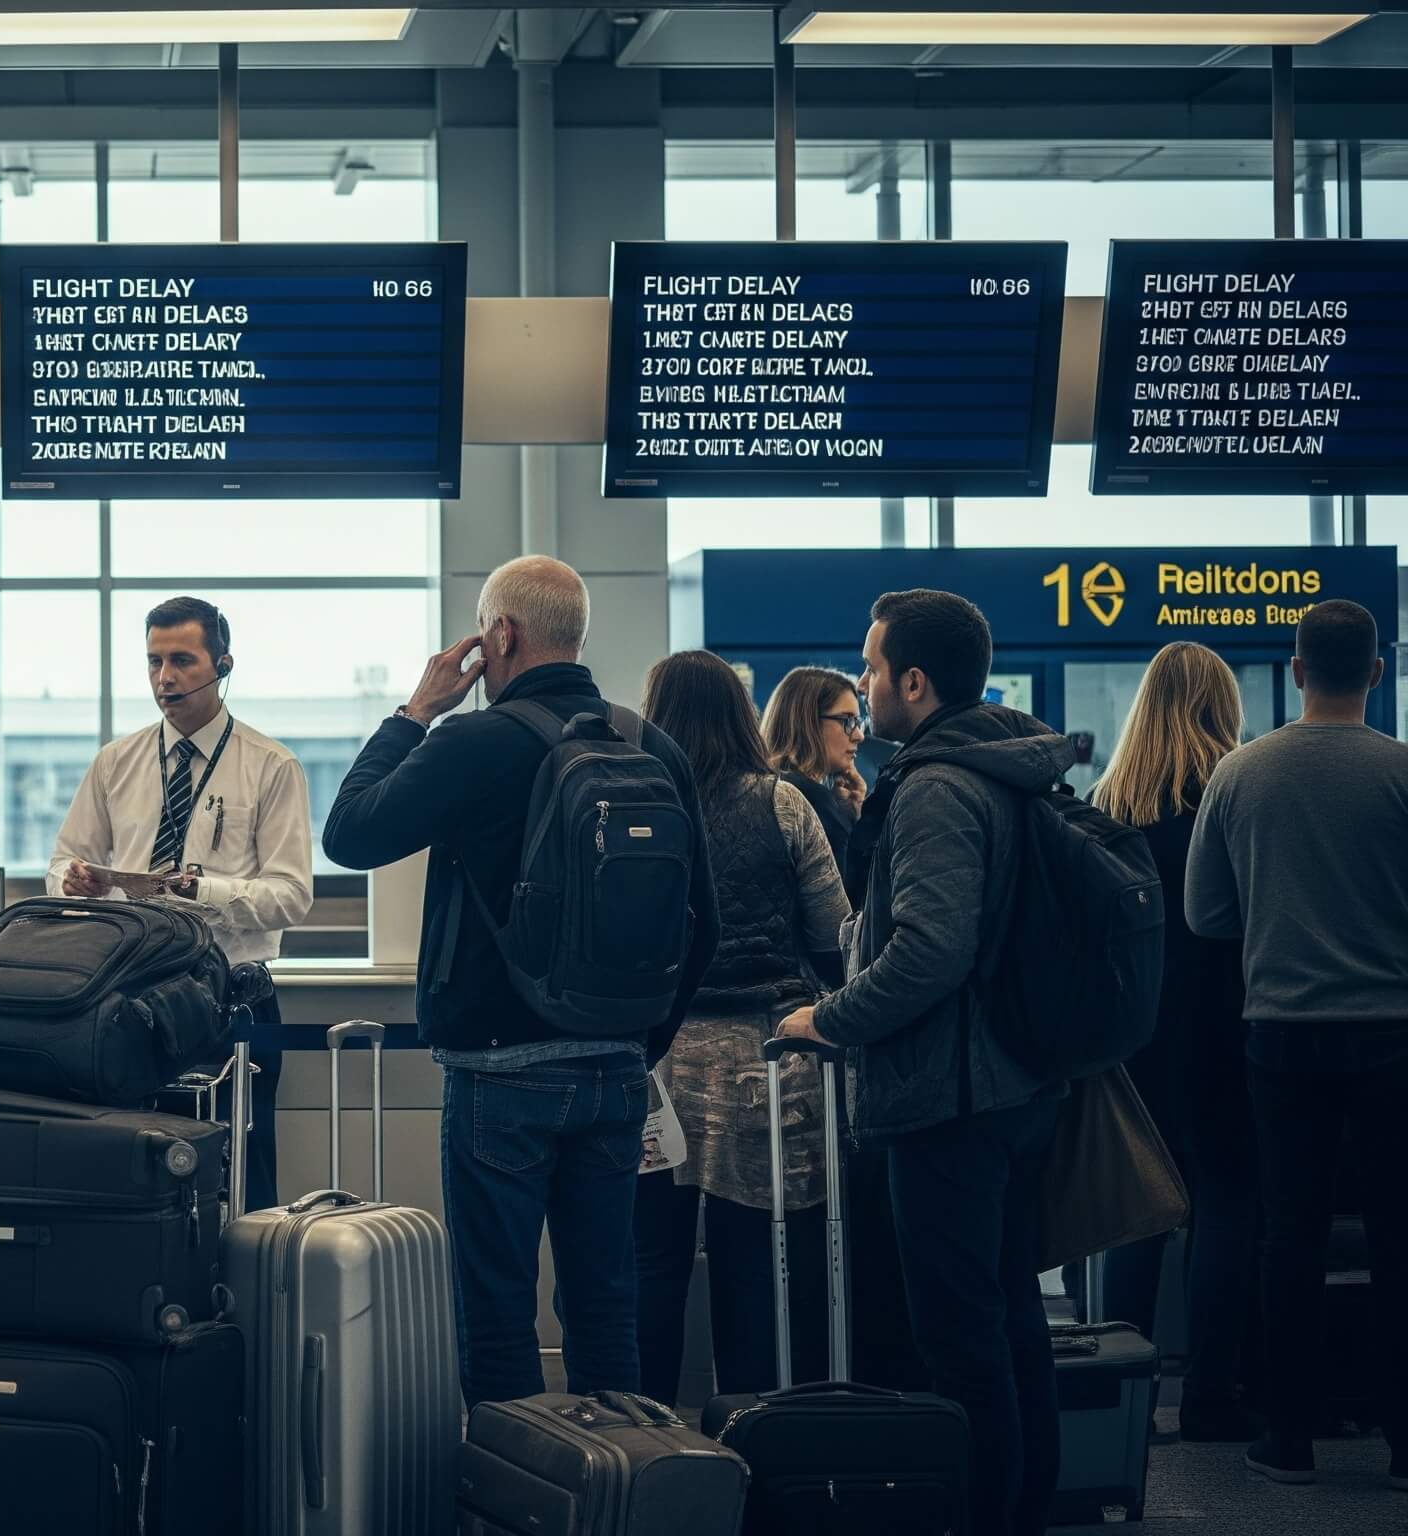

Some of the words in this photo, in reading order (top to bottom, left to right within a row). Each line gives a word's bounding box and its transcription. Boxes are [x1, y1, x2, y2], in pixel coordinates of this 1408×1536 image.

[32, 278, 114, 299] FLIGHT
[119, 278, 196, 299] DELAY
[404, 279, 433, 298] 66
[643, 275, 722, 296] FLIGHT
[727, 275, 801, 296] DELAY
[1002, 278, 1030, 296] 66
[1143, 273, 1219, 294] FLIGHT
[1224, 273, 1296, 294] DELAY
